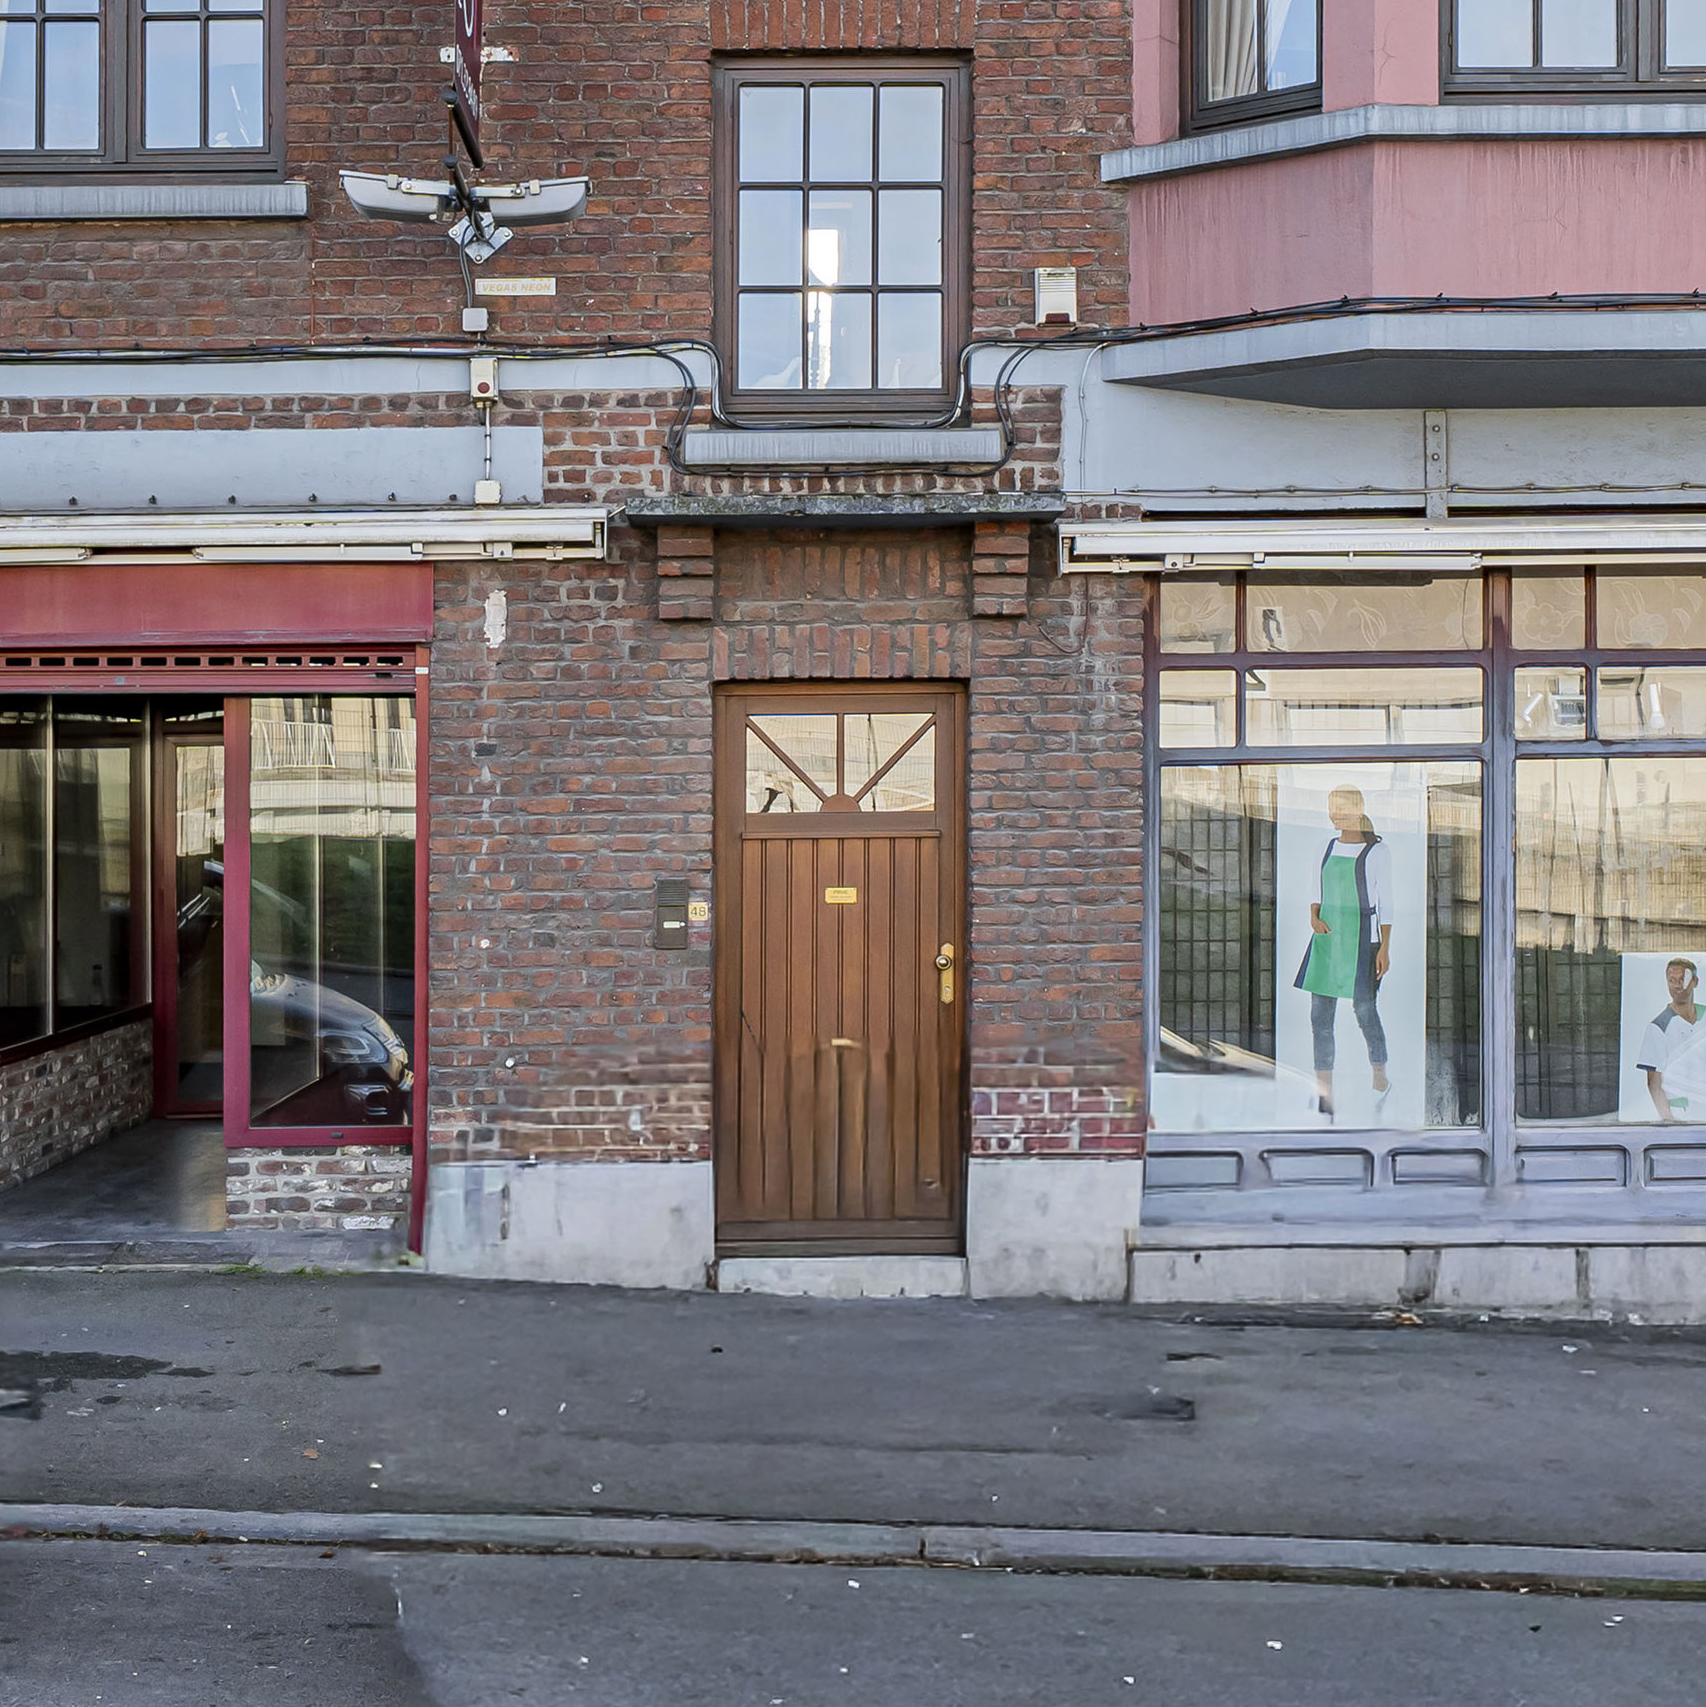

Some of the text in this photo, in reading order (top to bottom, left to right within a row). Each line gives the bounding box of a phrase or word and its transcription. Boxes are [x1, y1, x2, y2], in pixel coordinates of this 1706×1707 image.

[482, 283, 551, 292] VEGAS NEON
[690, 906, 706, 917] 48
